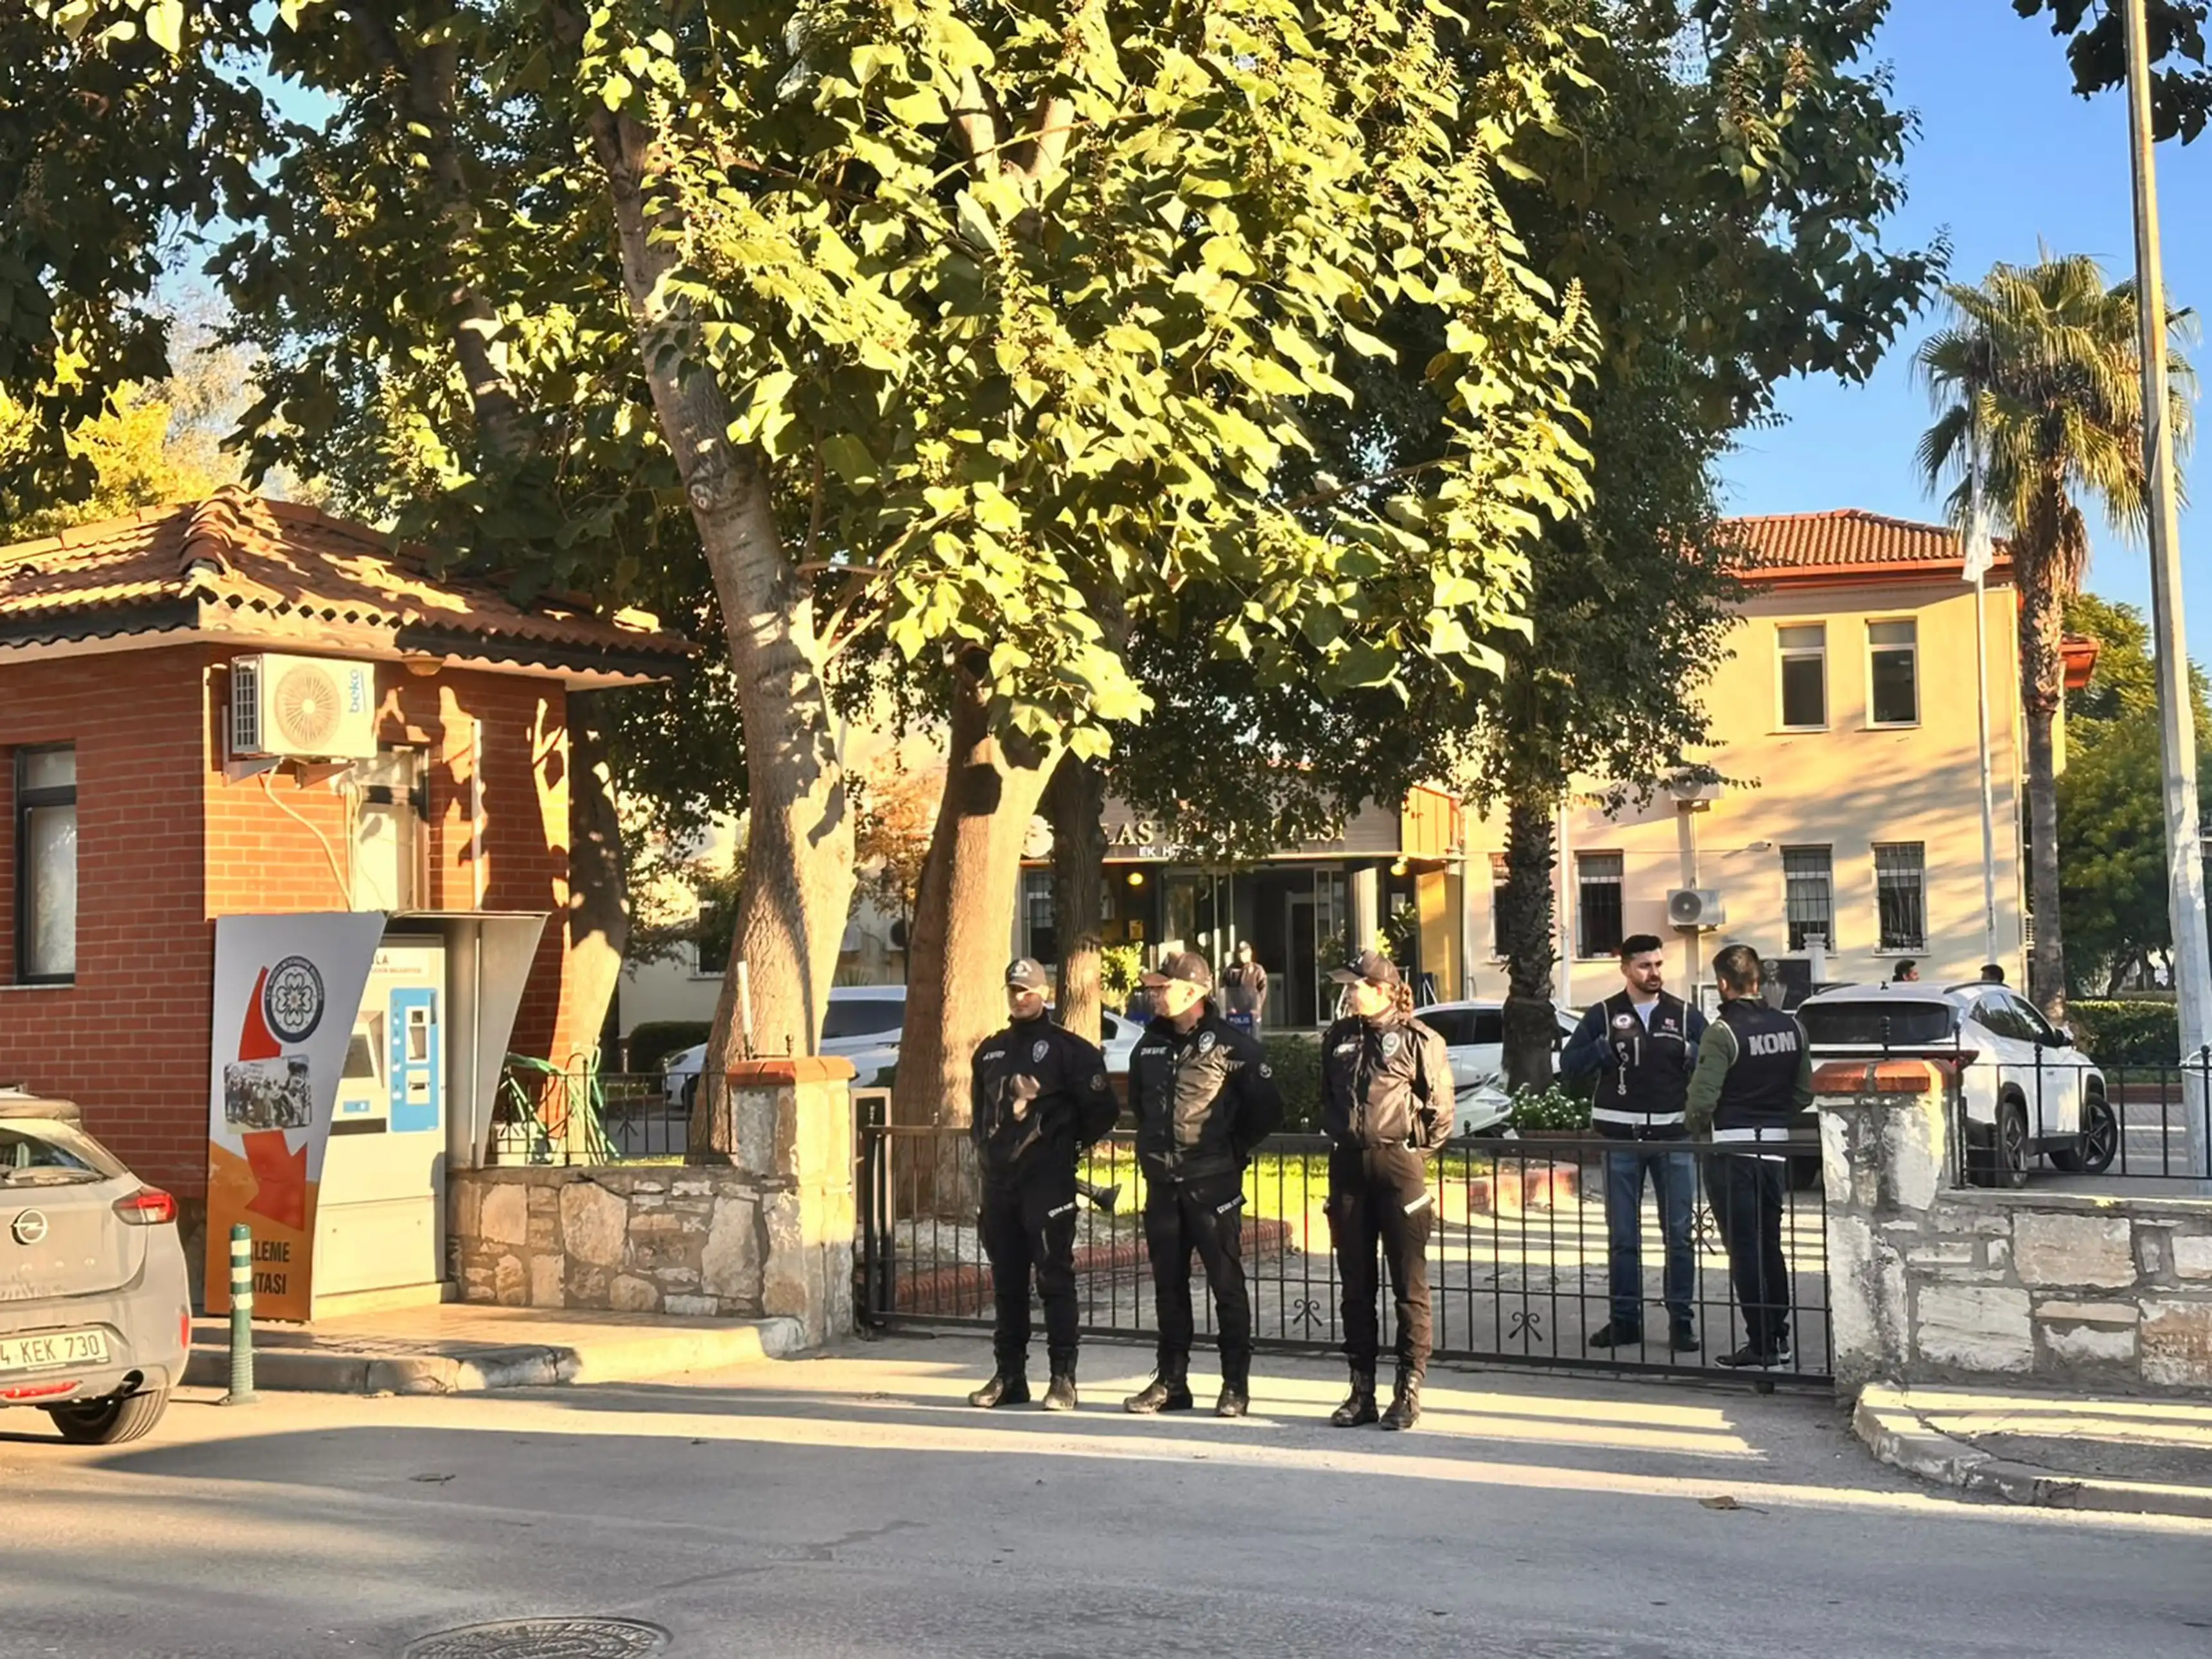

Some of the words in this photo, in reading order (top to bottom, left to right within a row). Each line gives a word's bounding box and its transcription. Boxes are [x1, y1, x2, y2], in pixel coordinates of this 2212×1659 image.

[348, 669, 360, 714] beko
[1748, 1031, 1797, 1056] KOM
[20, 1339, 57, 1364] KEK
[64, 1334, 100, 1358] 730
